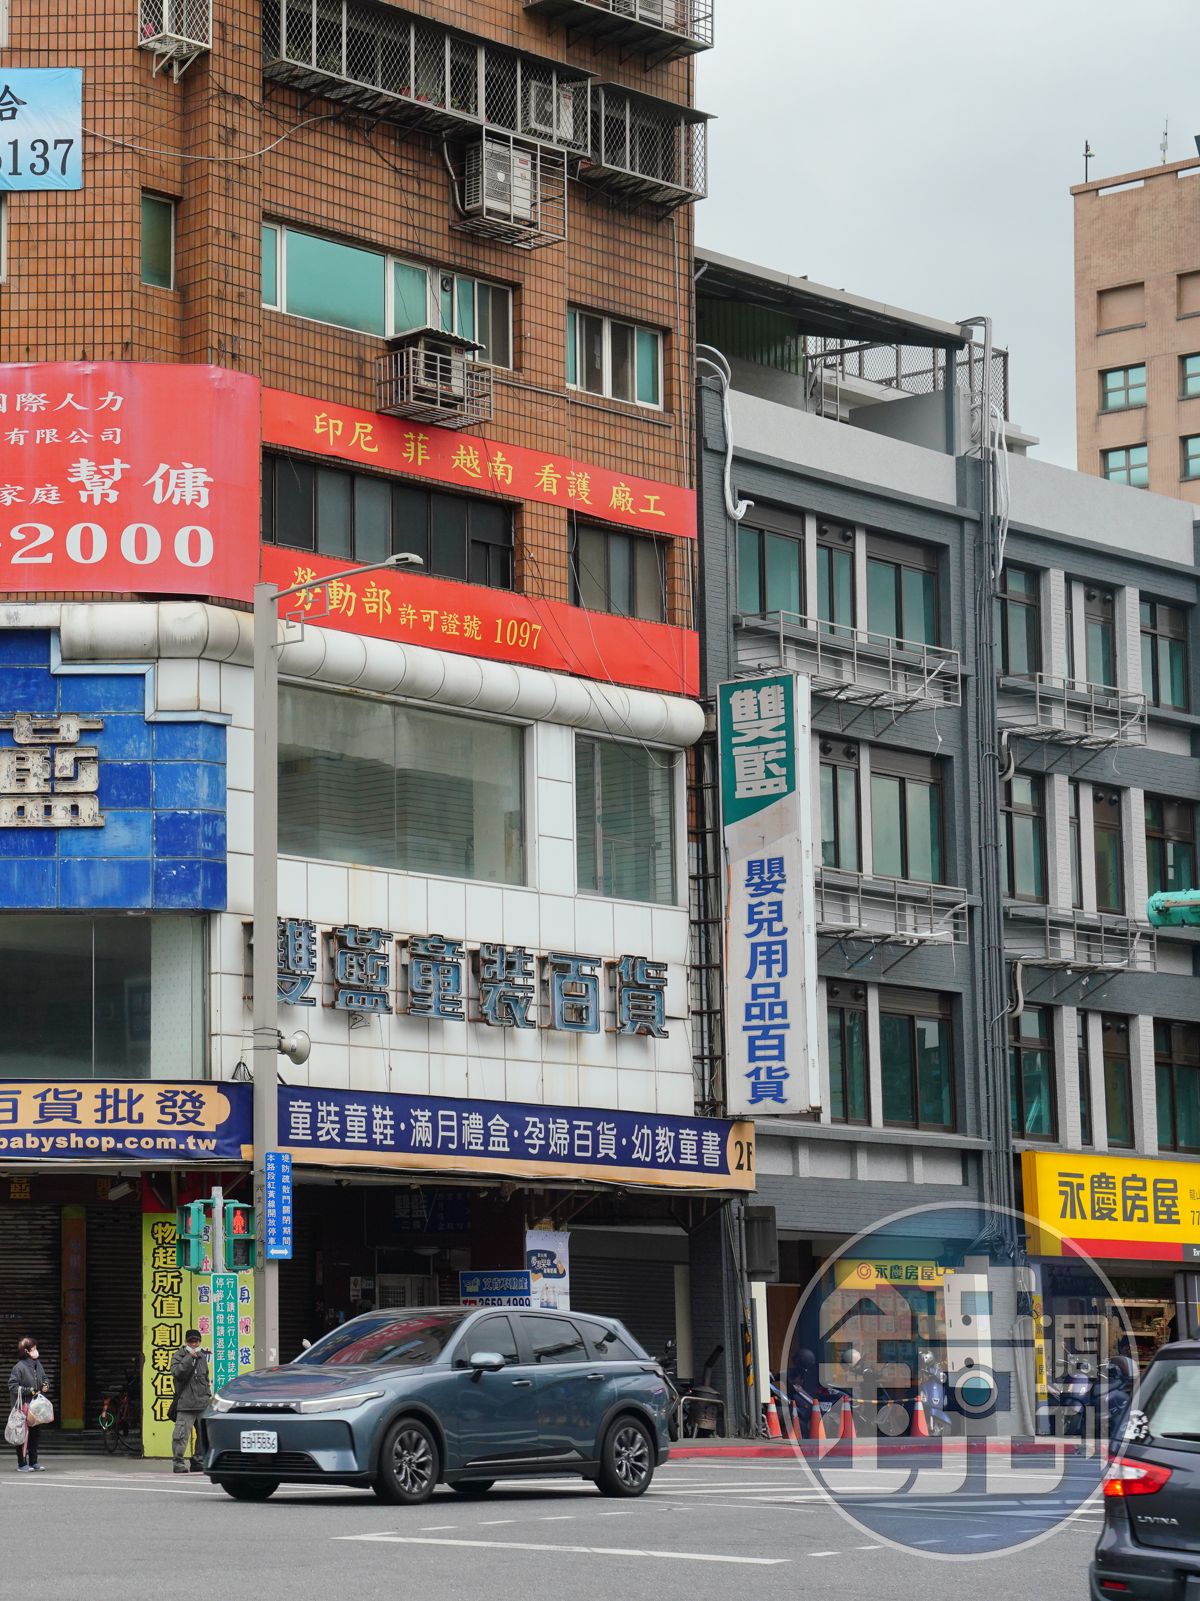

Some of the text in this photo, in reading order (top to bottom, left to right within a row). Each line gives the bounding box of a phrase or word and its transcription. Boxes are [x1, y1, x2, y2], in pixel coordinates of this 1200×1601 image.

[314, 412, 666, 517] 印尼 菲 越南 看護 廠工
[493, 617, 542, 650] 1097
[729, 684, 788, 799] 雙藍
[742, 857, 791, 1105] 嬰兒用品百貨
[733, 1140, 753, 1171] 2F
[1058, 1172, 1180, 1225] 永慶房屋
